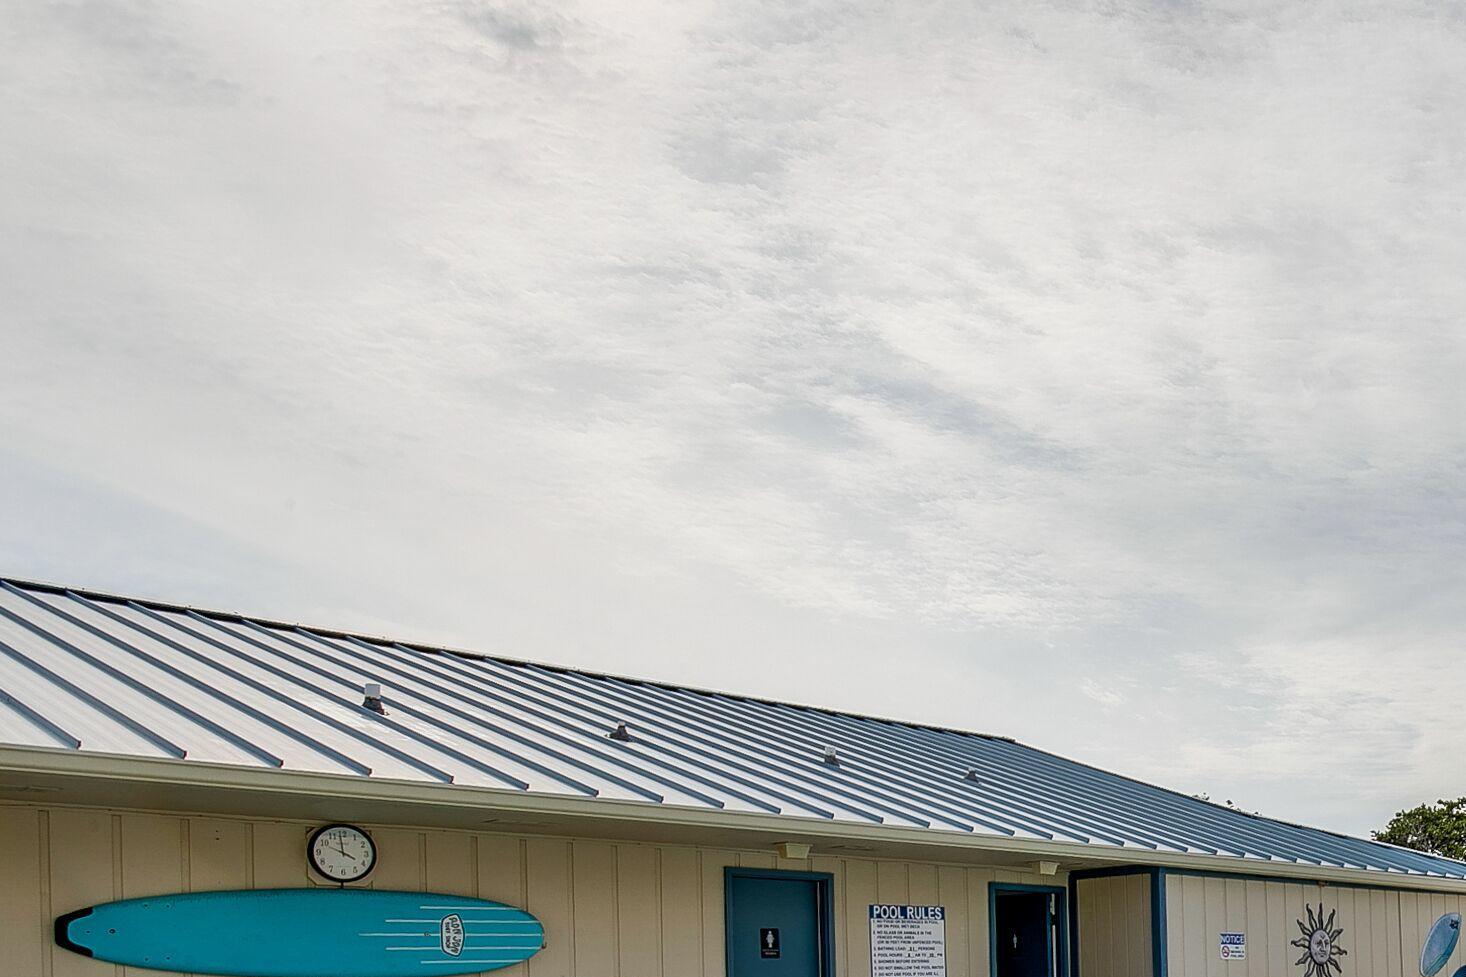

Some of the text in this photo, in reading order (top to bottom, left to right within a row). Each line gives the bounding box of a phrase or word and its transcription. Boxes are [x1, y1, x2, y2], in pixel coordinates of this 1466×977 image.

[873, 905, 942, 920] POOL RULES
[1220, 934, 1245, 944] NOTICE
